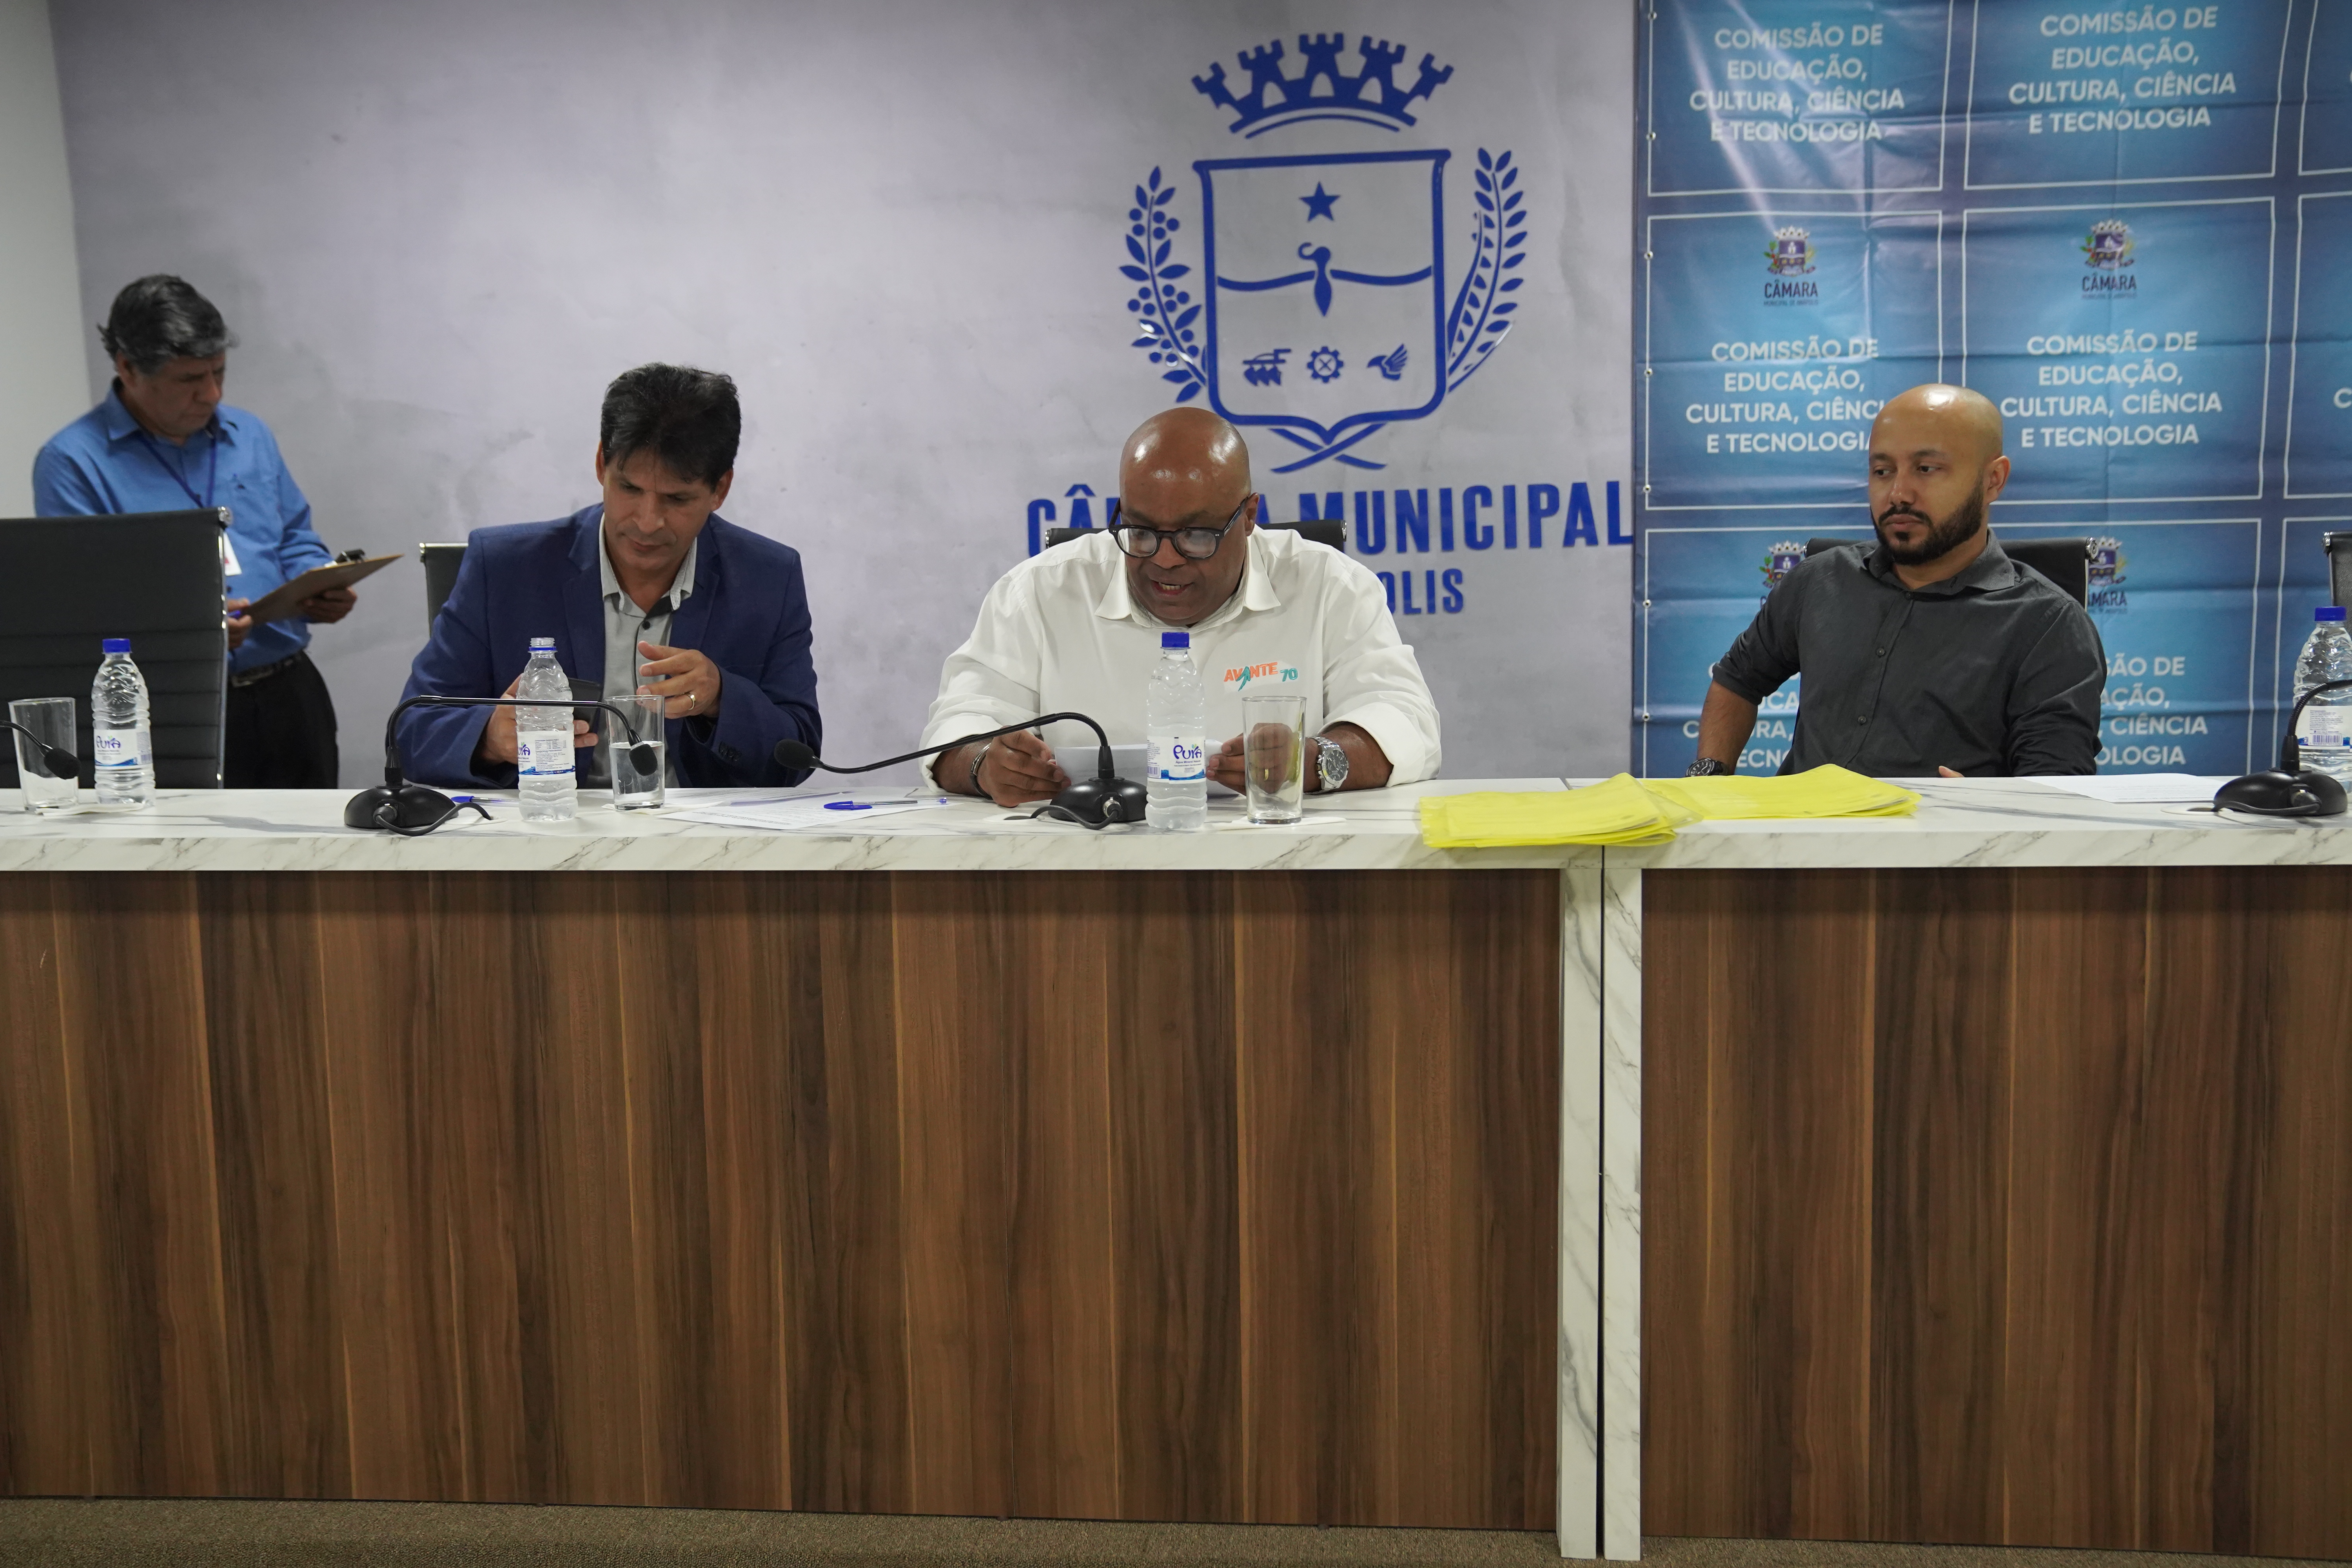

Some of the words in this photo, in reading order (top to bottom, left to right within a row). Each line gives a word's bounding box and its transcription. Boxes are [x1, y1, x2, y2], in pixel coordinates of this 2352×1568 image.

[2040, 5, 2176, 37] COMISSÃO
[2184, 6, 2218, 29] DE
[1715, 22, 1844, 49] COMISSÃO
[1851, 24, 1883, 46] DE
[2051, 38, 2200, 70] EDUCAÇÃO,
[1727, 54, 1867, 85] EDUCAÇÃO,
[2009, 79, 2125, 104] CULTURA,
[2134, 70, 2236, 98] CIÊNCIA
[1690, 90, 1800, 114] CULTURA,
[1807, 88, 1905, 111] CIÊNCIA
[1711, 122, 1723, 141] E
[1729, 121, 1882, 143] TECNOLOGIA
[2029, 114, 2043, 134] E
[2049, 106, 2211, 132] TECNOLOGIA
[1765, 279, 1818, 298] CÂMARA
[2082, 272, 2136, 291] CÂMARA
[1712, 336, 1841, 363] COMISSÃO
[1849, 338, 1878, 359] DE
[2027, 329, 2157, 356] COMISSÃO
[2165, 332, 2198, 352] DE
[1725, 365, 1865, 395] EDUCAÇÃO,
[2039, 358, 2183, 389] EDUCAÇÃO,
[1686, 403, 1798, 425] CULTURA,
[1806, 396, 1884, 421] CIÊNC
[2000, 395, 2114, 418] CULTURA,
[2122, 389, 2223, 415] CIÊNCIA
[1707, 434, 1719, 454] E
[1726, 430, 1869, 454] TECNOLOGI
[2022, 428, 2035, 448] E
[2041, 424, 2200, 448] TECNOLOGIA
[1375, 568, 1463, 615] OLIS
[2088, 591, 2127, 606] MARA
[1223, 662, 1278, 691] AVANTE
[1280, 668, 1298, 682] 70
[2154, 656, 2185, 676] DE
[2100, 682, 2170, 711] AÇÃO,
[2110, 712, 2209, 735] CIÊNCIA
[2094, 746, 2186, 765] OLOGIA
